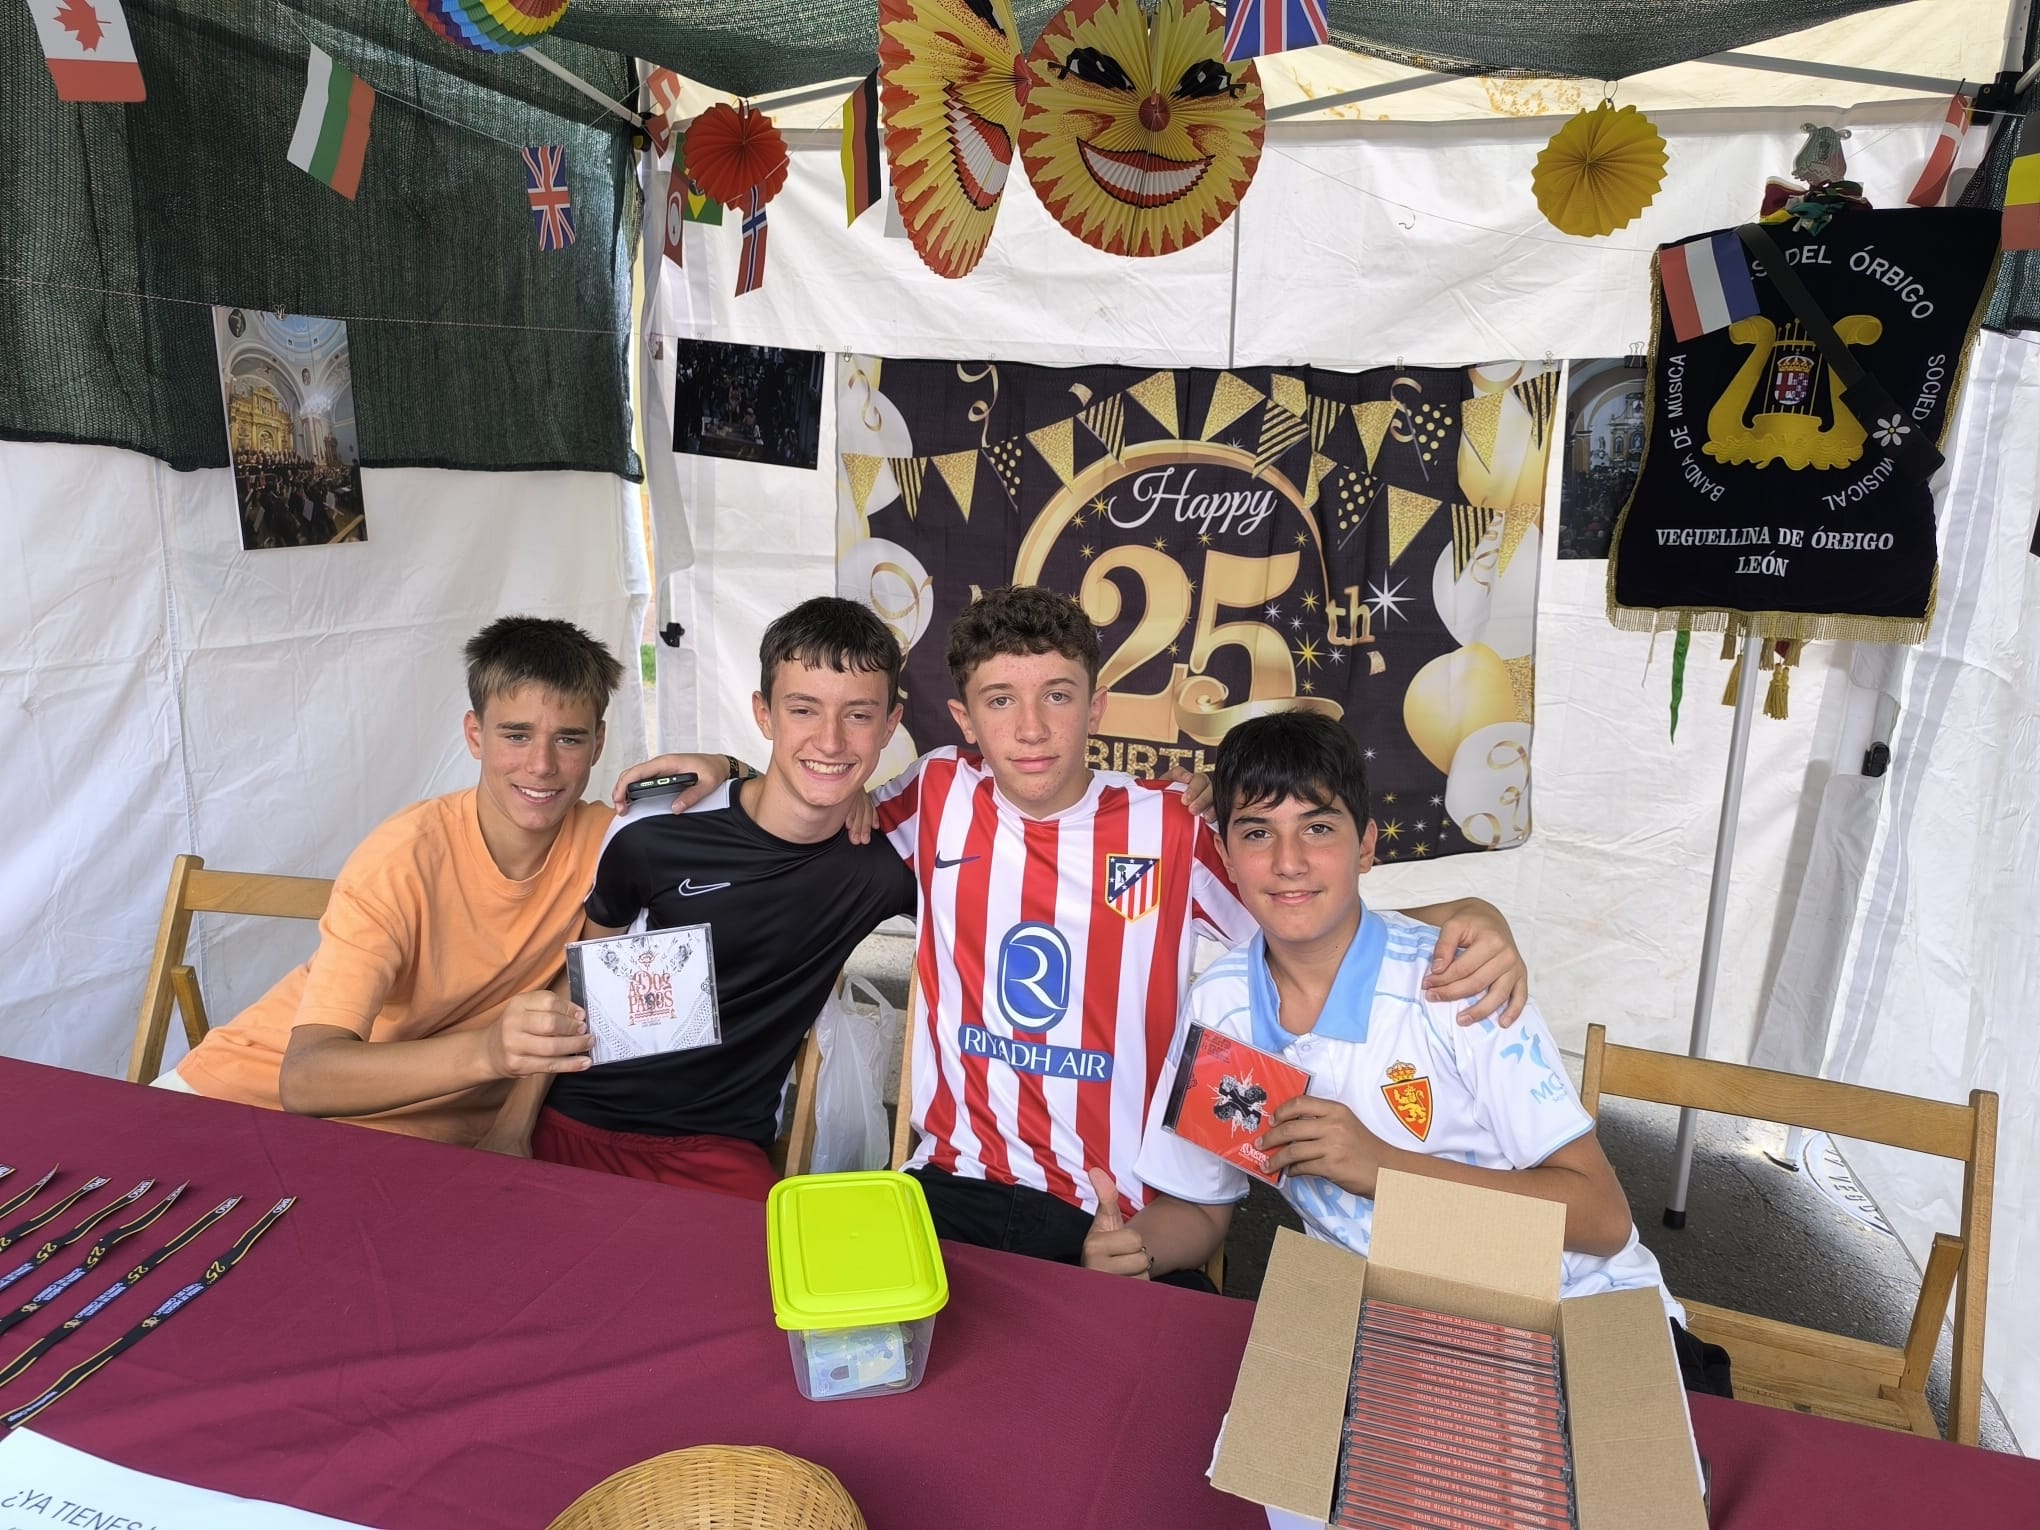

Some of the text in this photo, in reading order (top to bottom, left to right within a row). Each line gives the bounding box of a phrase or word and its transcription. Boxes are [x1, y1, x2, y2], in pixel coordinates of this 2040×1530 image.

[1785, 245, 1934, 319] DEL ÓRBIGO
[1911, 354, 1946, 429] SOCIED
[1664, 354, 1725, 502] BANDA DE MÚSICA
[1108, 466, 1277, 535] Happy
[1656, 525, 1894, 550] VEGUELLINA DE ÓRBIGO
[1735, 550, 1789, 577] LEÓN
[1080, 545, 1301, 743] 25
[964, 1027, 1106, 1078] RIYADH AIR
[1, 1489, 53, 1515] ¿YA
